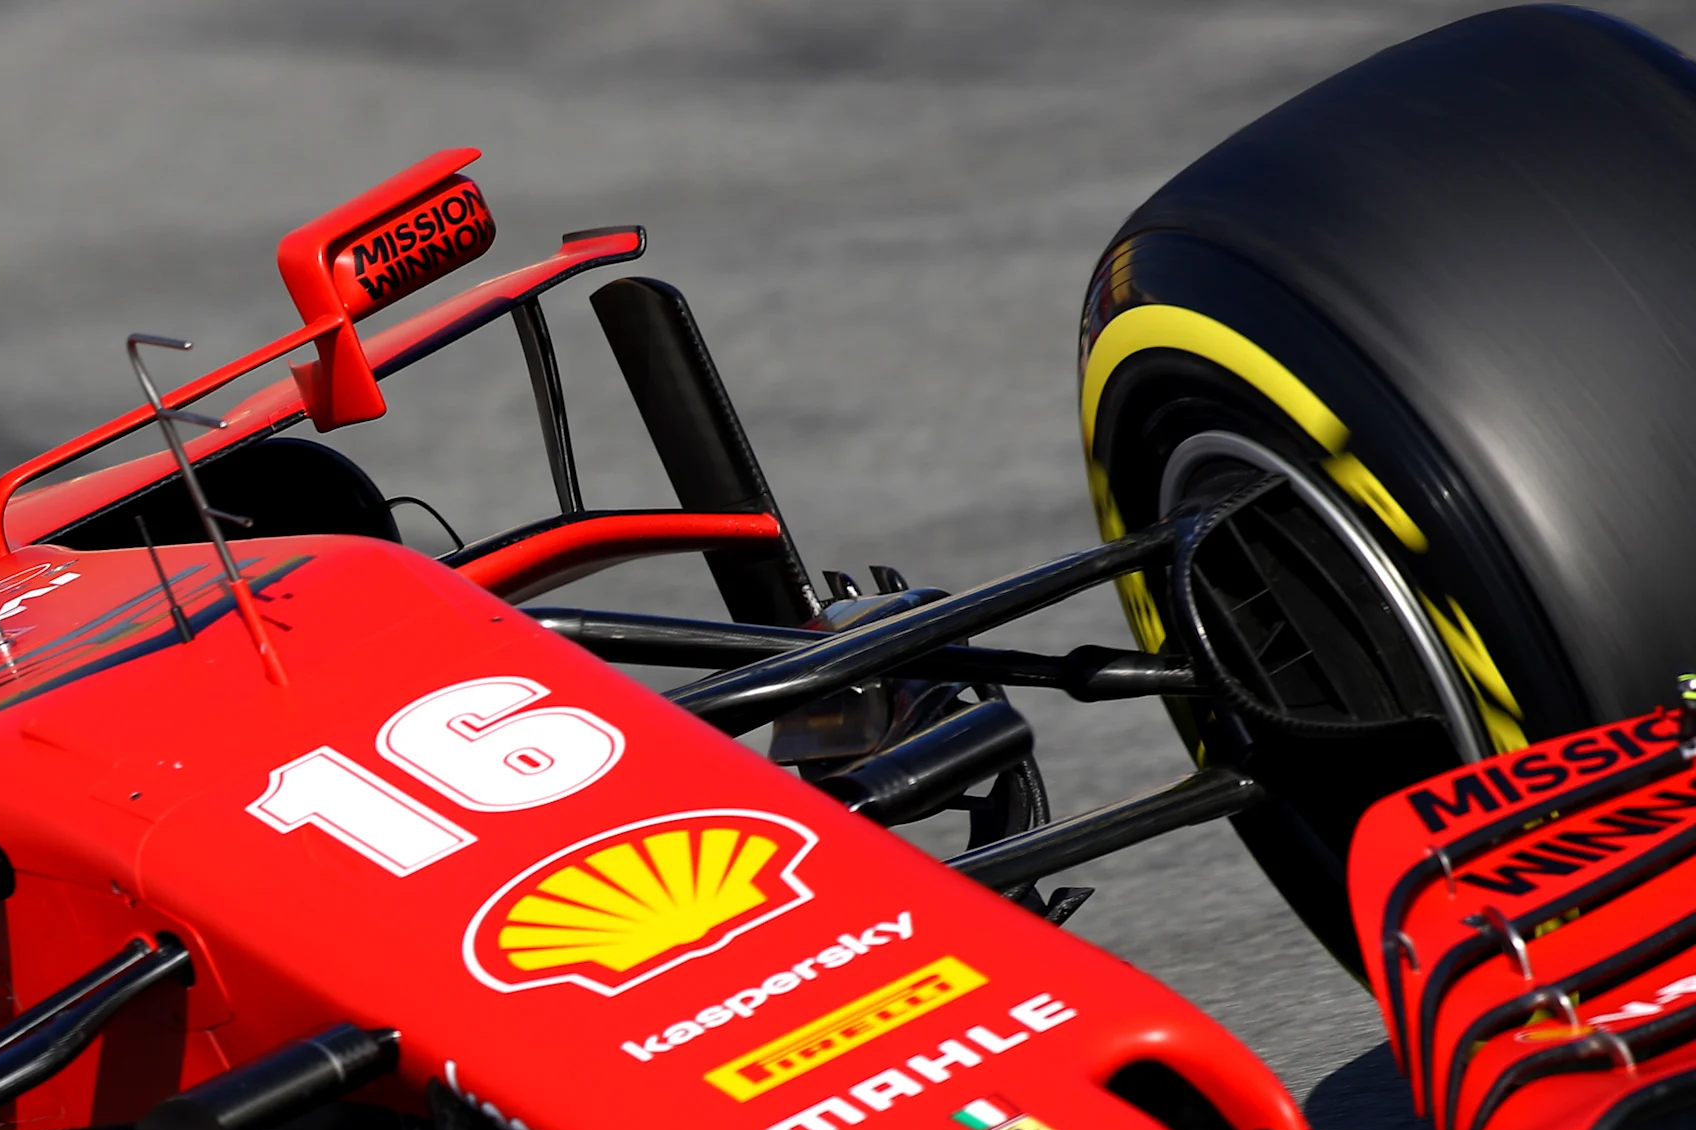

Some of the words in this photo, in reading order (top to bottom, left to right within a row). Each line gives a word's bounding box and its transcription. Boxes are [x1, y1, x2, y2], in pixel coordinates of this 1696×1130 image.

[352, 189, 487, 277] MISSION
[244, 676, 626, 878] 16
[1407, 716, 1682, 834] MISSIO
[621, 911, 916, 1062] kaspersky
[736, 973, 954, 1085] PIRELLI
